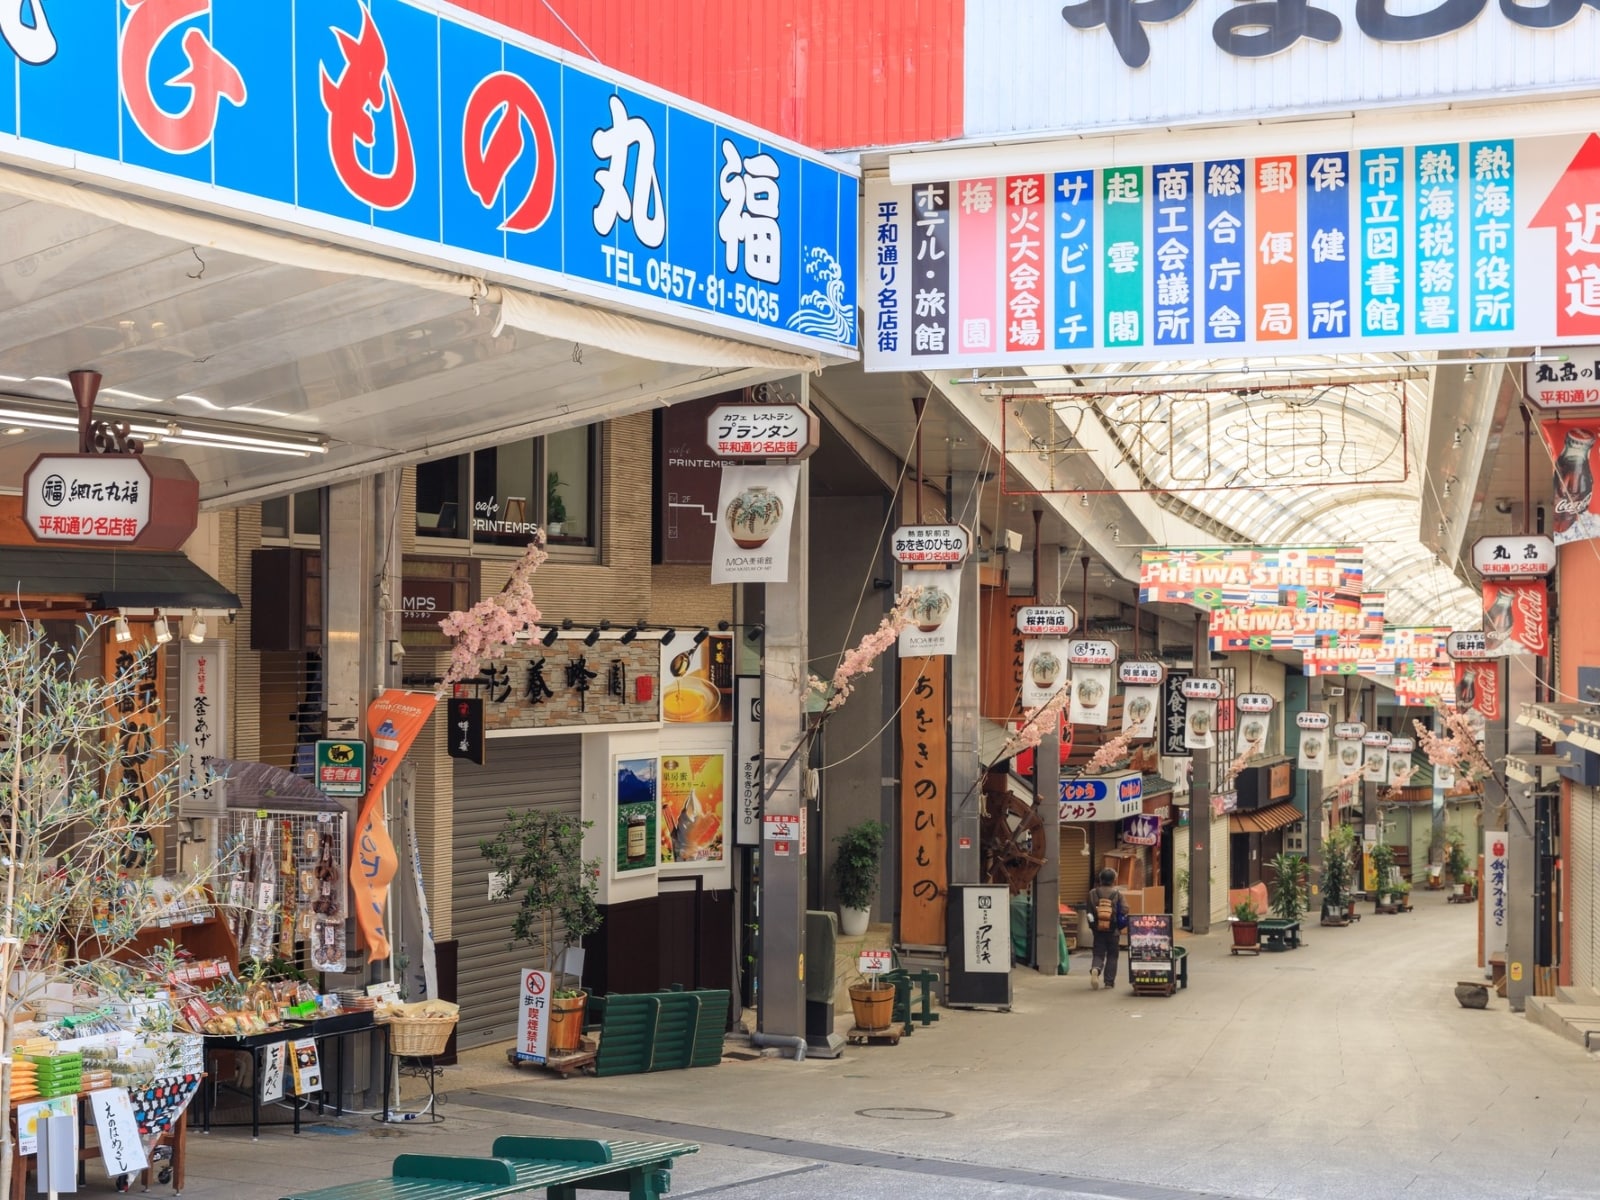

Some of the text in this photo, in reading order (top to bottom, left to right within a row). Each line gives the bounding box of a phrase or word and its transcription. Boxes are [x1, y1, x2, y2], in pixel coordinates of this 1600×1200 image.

[590, 94, 781, 284] 丸福
[1156, 167, 1190, 341] 商工会議所
[1207, 163, 1242, 340] 総合庁舎
[1258, 160, 1294, 336] 郵便局
[1310, 157, 1347, 334] 保健所
[1364, 153, 1401, 332] 市立図書館
[1418, 149, 1457, 330] 熱海税務署
[1473, 144, 1513, 329] 熱海市役所
[601, 244, 642, 286] TEL
[877, 202, 898, 353] 平和通り名店街
[961, 182, 993, 349] 梅園
[1009, 177, 1041, 347] 花火大会会場
[1057, 175, 1088, 344] サンビーチ
[1107, 172, 1140, 343] 起雲閣
[718, 423, 799, 440] プランタン
[723, 412, 793, 422] カフェ レストラン
[717, 441, 799, 454] 平和通り名店街
[68, 479, 140, 504] 網元丸福
[475, 496, 500, 518] cafe
[38, 515, 138, 537] 平和通り名店街
[472, 519, 538, 535] PRINTEMPS
[896, 539, 963, 551] あをきのひもの
[899, 552, 960, 561] 平和通り名店街
[1159, 564, 1341, 587] HEIWA STREET
[1482, 563, 1548, 573] 平和通り名店街
[1026, 616, 1065, 626] 桜井商店
[1223, 612, 1367, 631] HEIWA STREET
[1316, 644, 1437, 659] HEIWA STREET
[1405, 679, 1455, 694] HEIWA
[1167, 675, 1186, 753] お食事処
[323, 768, 359, 781] 宅急便
[912, 675, 940, 903] あをきのひもの
[979, 924, 993, 965] アオキ
[524, 994, 545, 1009] 歩行
[525, 1007, 540, 1054] 喫煙禁止
